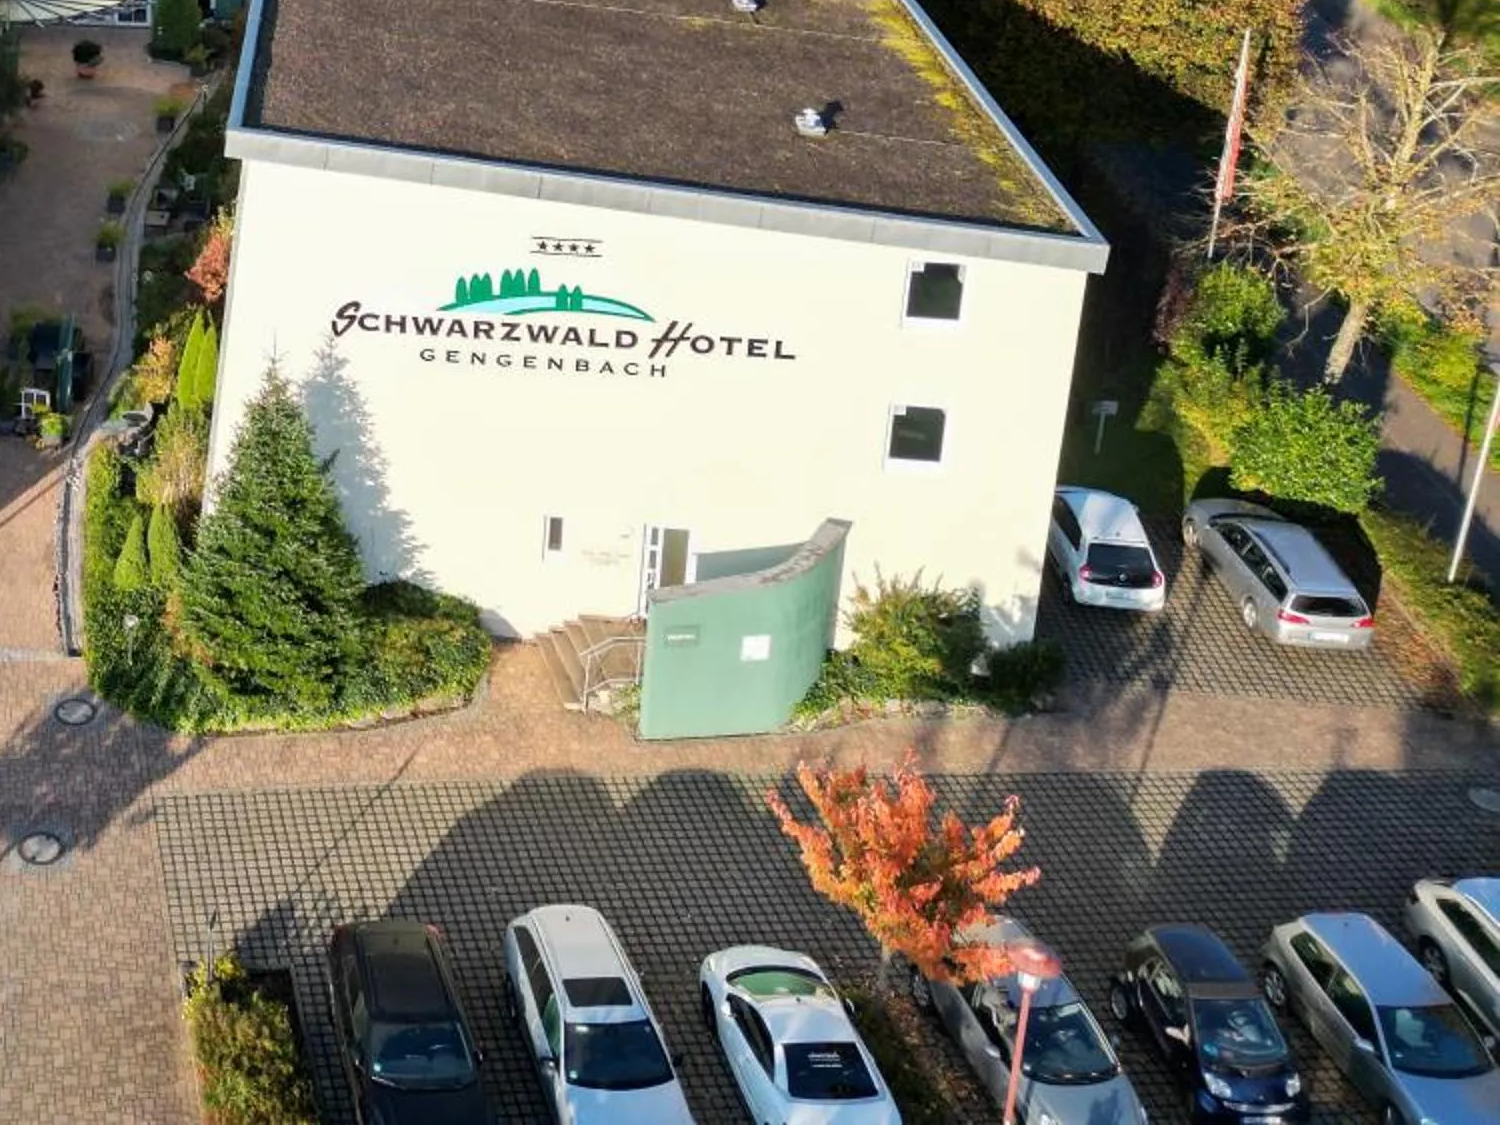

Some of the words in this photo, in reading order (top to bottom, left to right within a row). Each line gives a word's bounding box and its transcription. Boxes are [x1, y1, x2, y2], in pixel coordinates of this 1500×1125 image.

[331, 300, 639, 350] SCHWARZWALD
[648, 320, 797, 361] HOTEL
[419, 348, 667, 378] GENGENBACH
